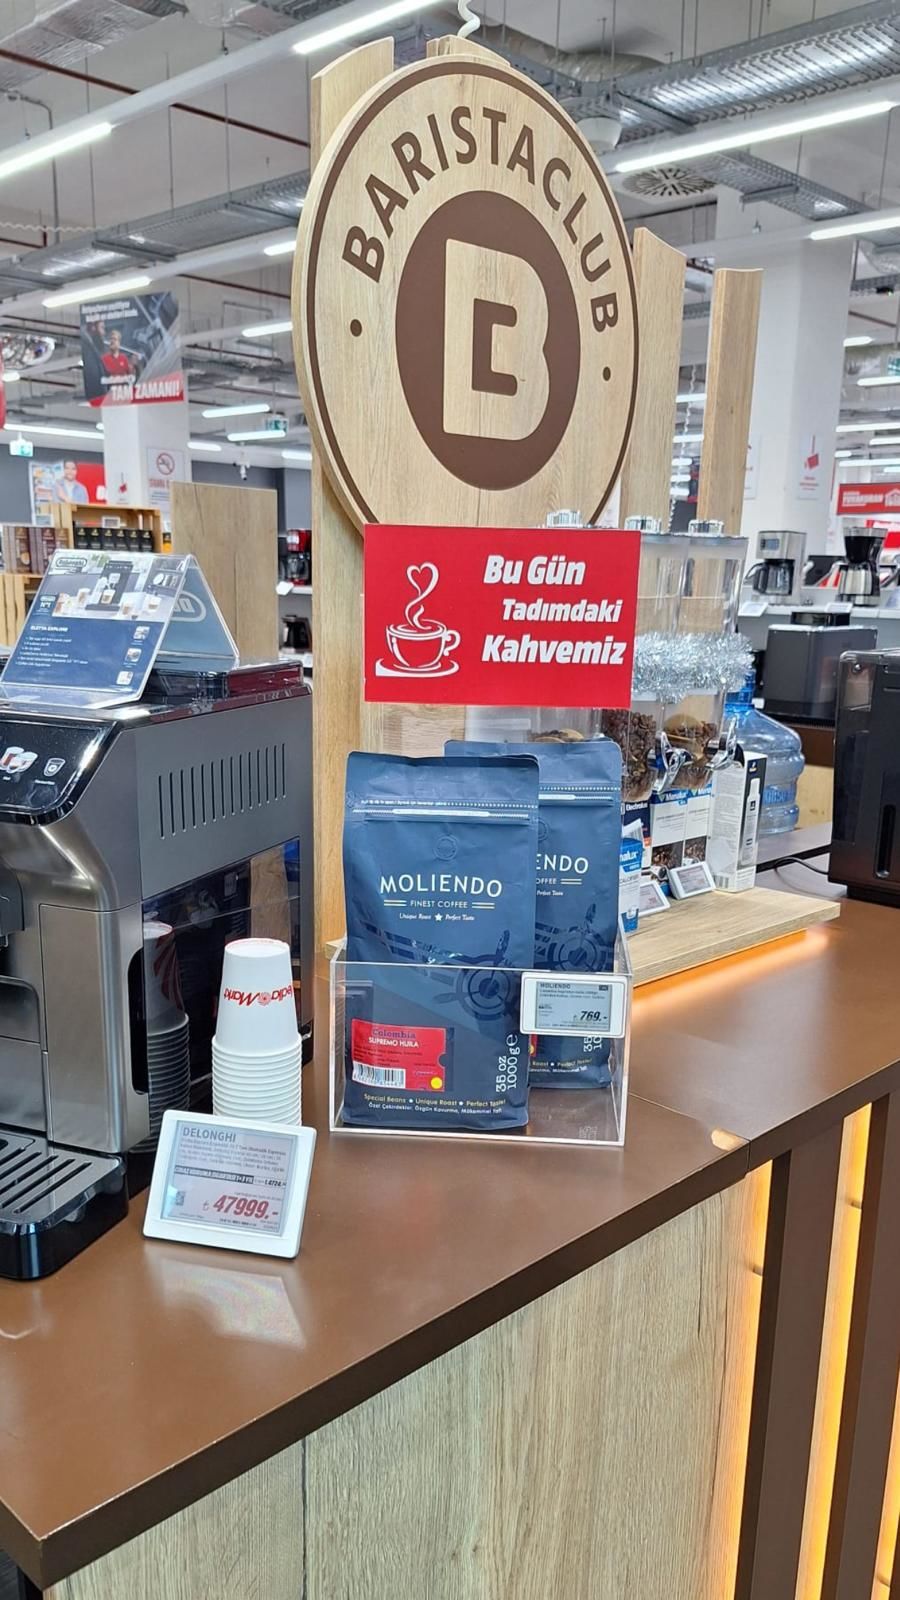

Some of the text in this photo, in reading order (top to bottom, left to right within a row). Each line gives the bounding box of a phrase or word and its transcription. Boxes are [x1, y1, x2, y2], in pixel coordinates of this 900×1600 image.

[342, 106, 618, 333] BARISTACLUB
[111, 380, 180, 402] TAM ZAMANI!
[484, 554, 586, 586] Bu Gün
[502, 598, 623, 623] Tadımdaki
[481, 633, 627, 665] Kahvemiz
[380, 873, 503, 898] MOLIENDO
[410, 900, 468, 909] FINEST COFFEE
[368, 1037, 419, 1048] SUPREMO HUILA
[372, 1028, 417, 1039] Colombia
[363, 1092, 386, 1102] Special
[386, 1095, 406, 1104] Beans
[415, 1098, 437, 1106] Unique
[466, 1099, 488, 1107] Perfect
[183, 1127, 236, 1143] DELONGHI
[213, 1194, 279, 1219] 47999.-
